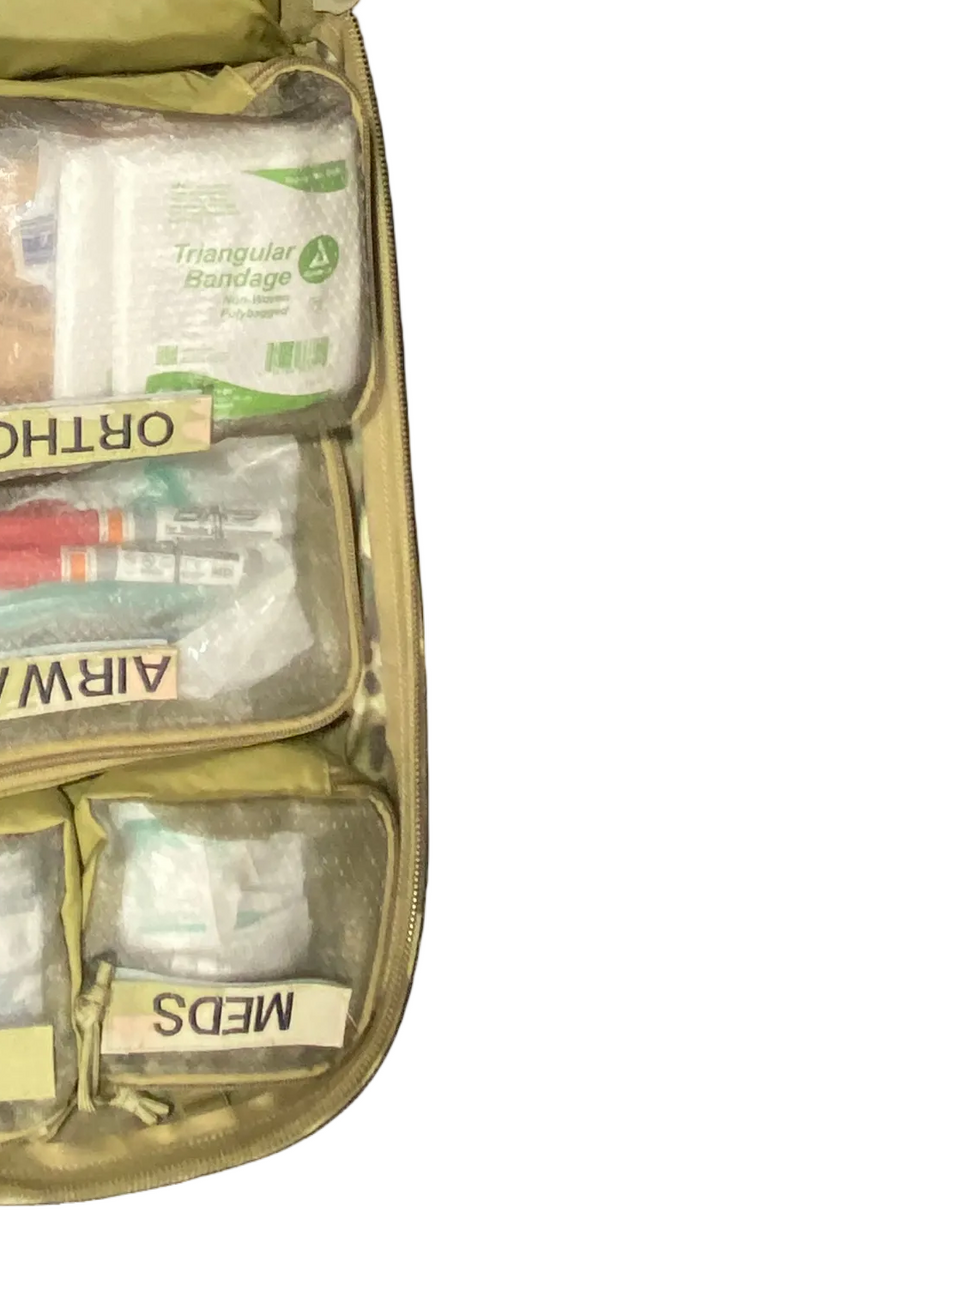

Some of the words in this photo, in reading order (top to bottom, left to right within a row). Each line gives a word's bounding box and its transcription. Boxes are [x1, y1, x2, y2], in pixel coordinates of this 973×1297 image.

[174, 241, 297, 267] Triangular
[183, 268, 292, 292] Bandage
[153, 992, 294, 1036] MEDS
